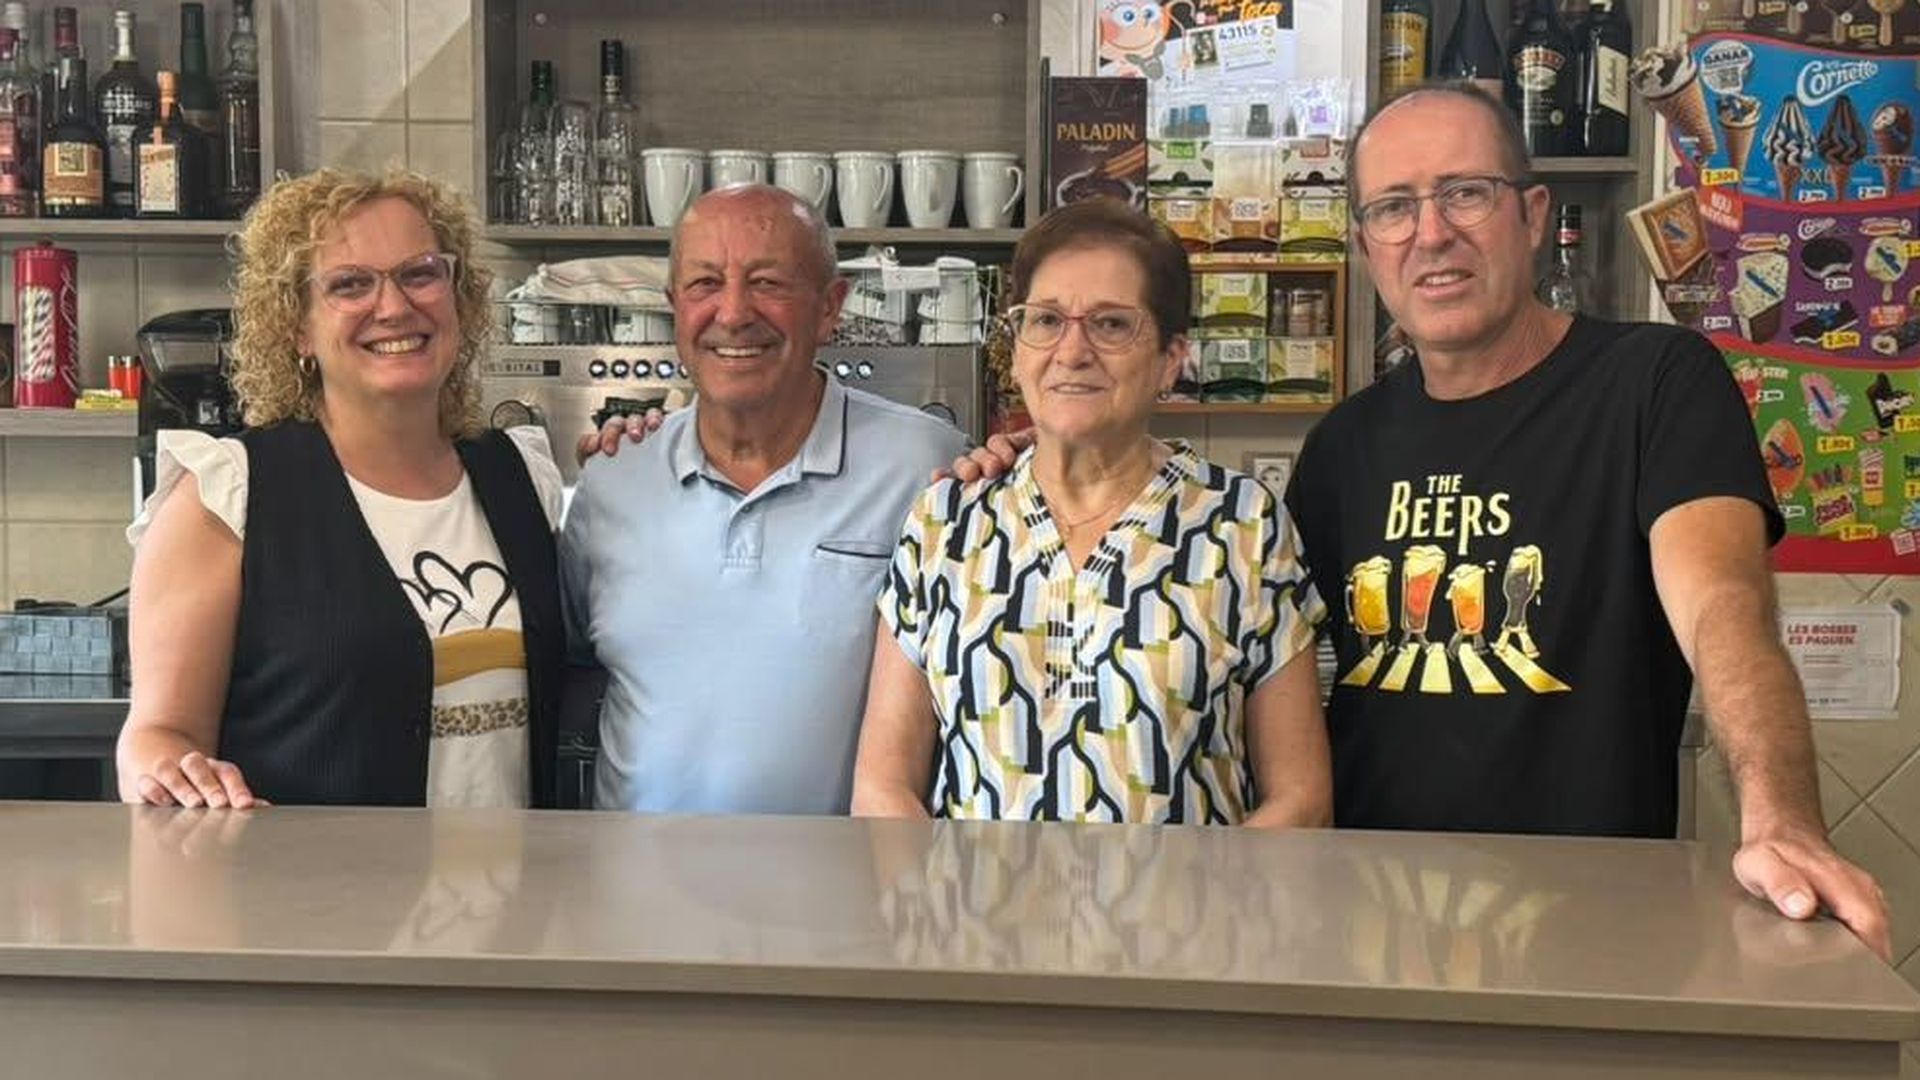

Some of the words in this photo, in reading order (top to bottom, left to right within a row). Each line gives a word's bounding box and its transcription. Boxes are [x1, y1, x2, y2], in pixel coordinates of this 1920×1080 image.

[1797, 60, 1879, 107] Cornetto
[1057, 122, 1136, 141] PALADIN
[1427, 474, 1463, 495] THE
[1385, 480, 1511, 556] BEERS
[1787, 624, 1809, 634] LES
[1812, 624, 1857, 634] BOSSES
[1789, 636, 1804, 645] ES
